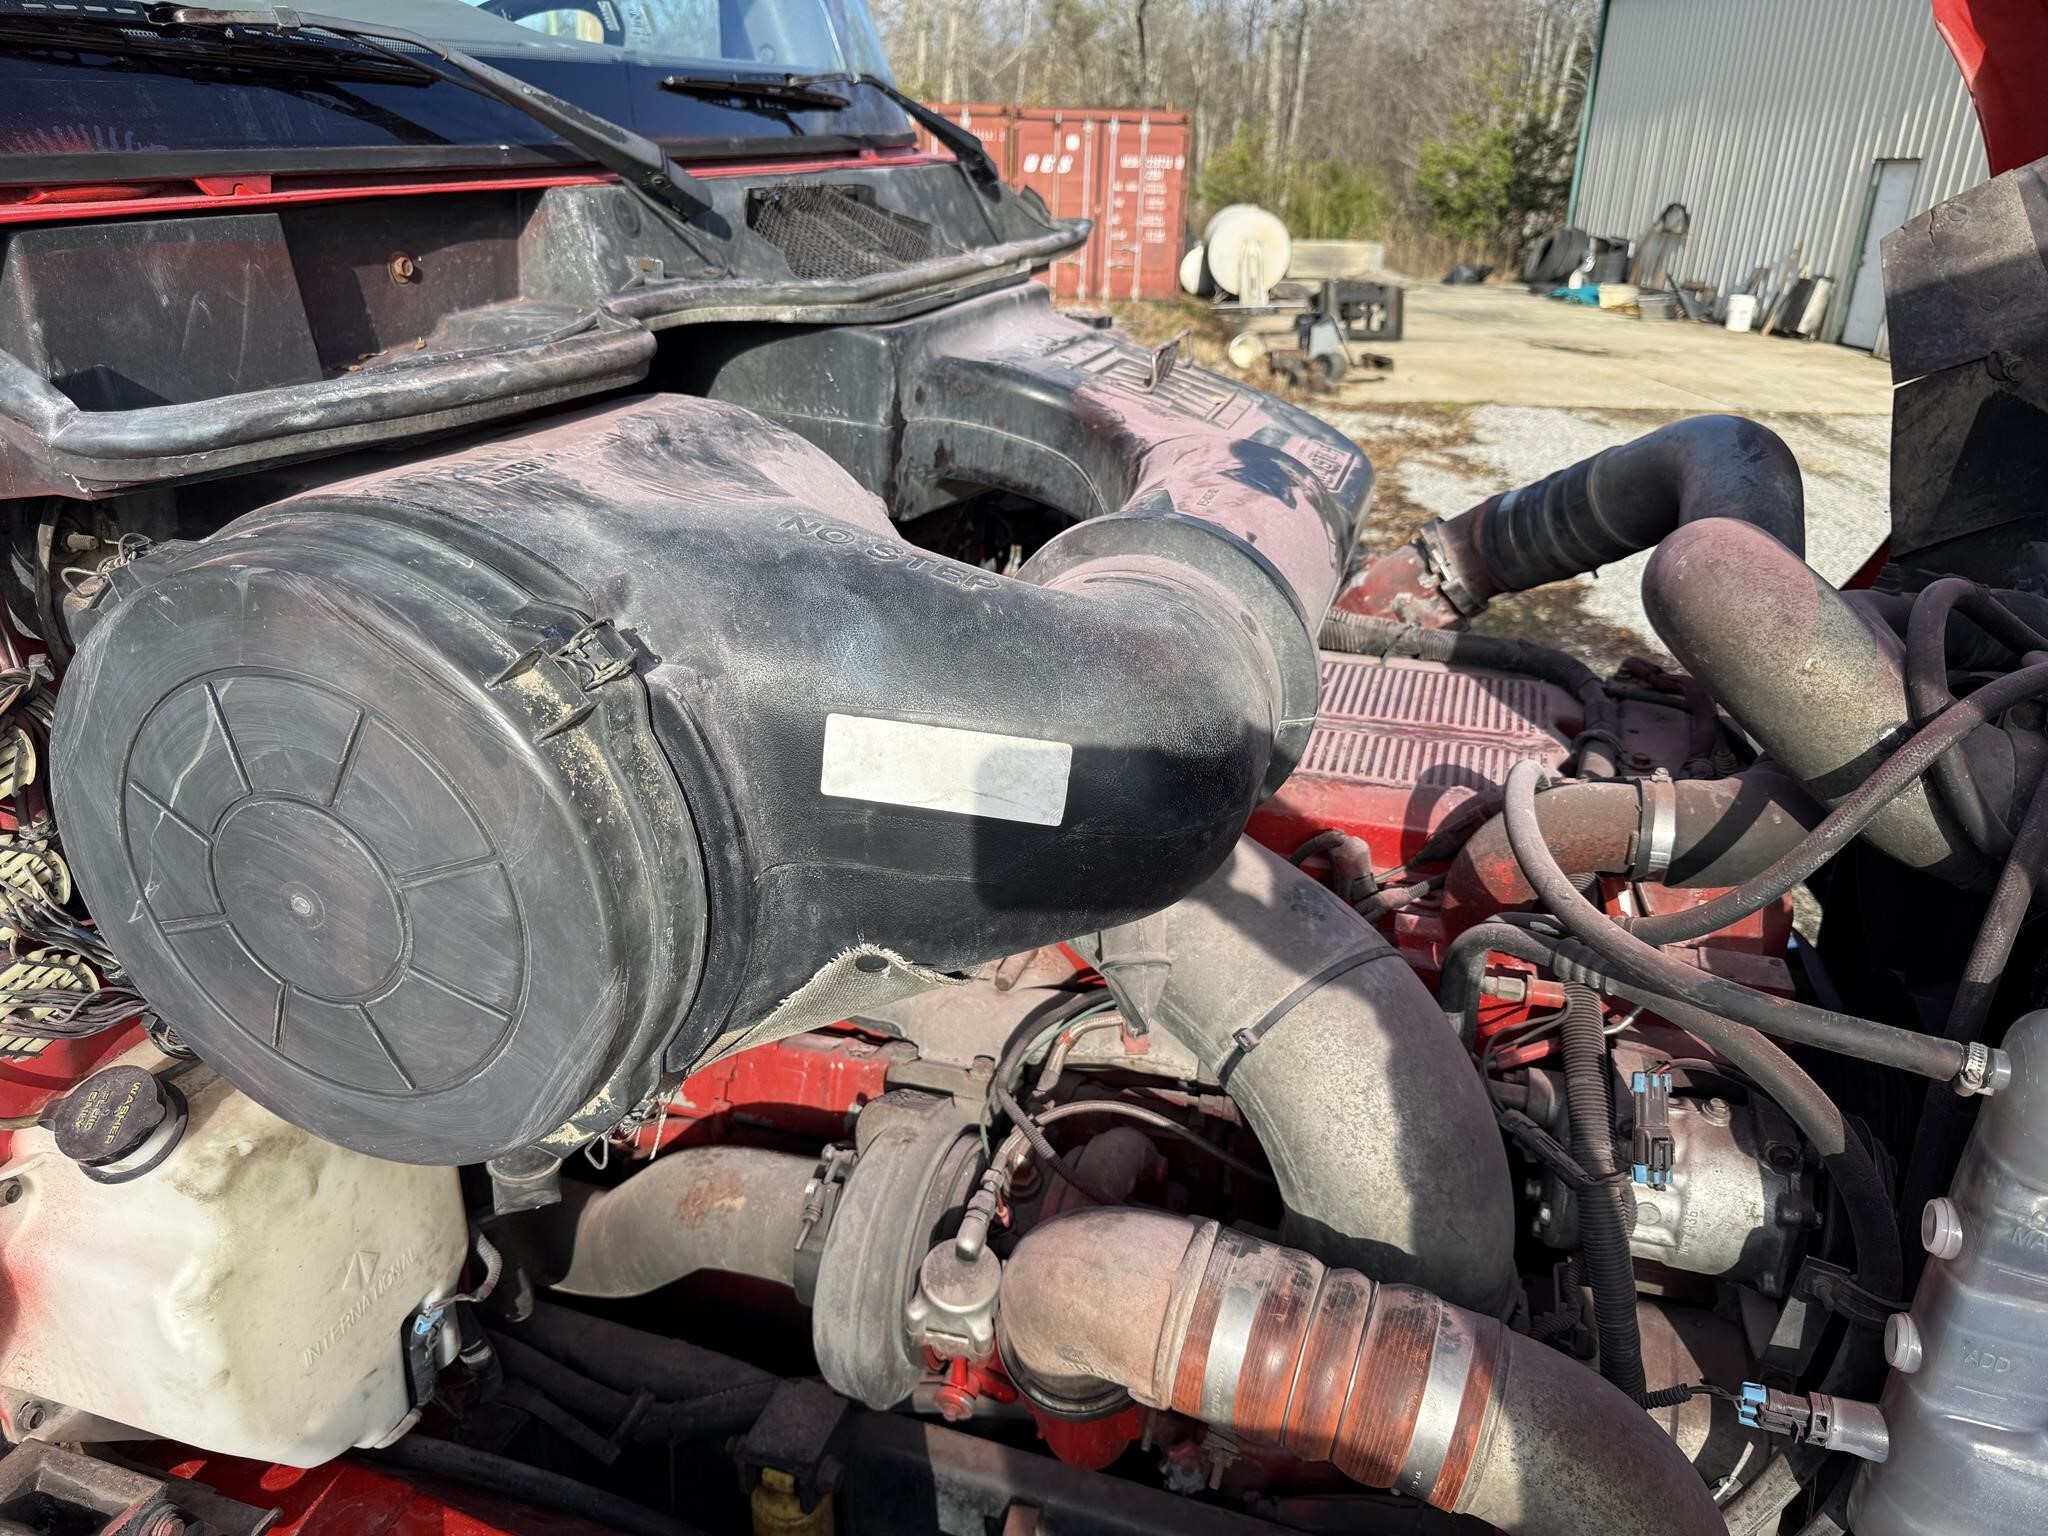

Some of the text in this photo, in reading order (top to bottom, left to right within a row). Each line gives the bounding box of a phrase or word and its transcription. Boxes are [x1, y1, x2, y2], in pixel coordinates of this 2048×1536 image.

[778, 514, 1002, 592] NO STEP
[75, 1089, 99, 1130] ONLY
[85, 1089, 111, 1131] FLUID
[105, 1081, 141, 1145] WASHER
[302, 1243, 418, 1369] INTERNATIONAL
[1963, 1350, 2012, 1374] ADD
